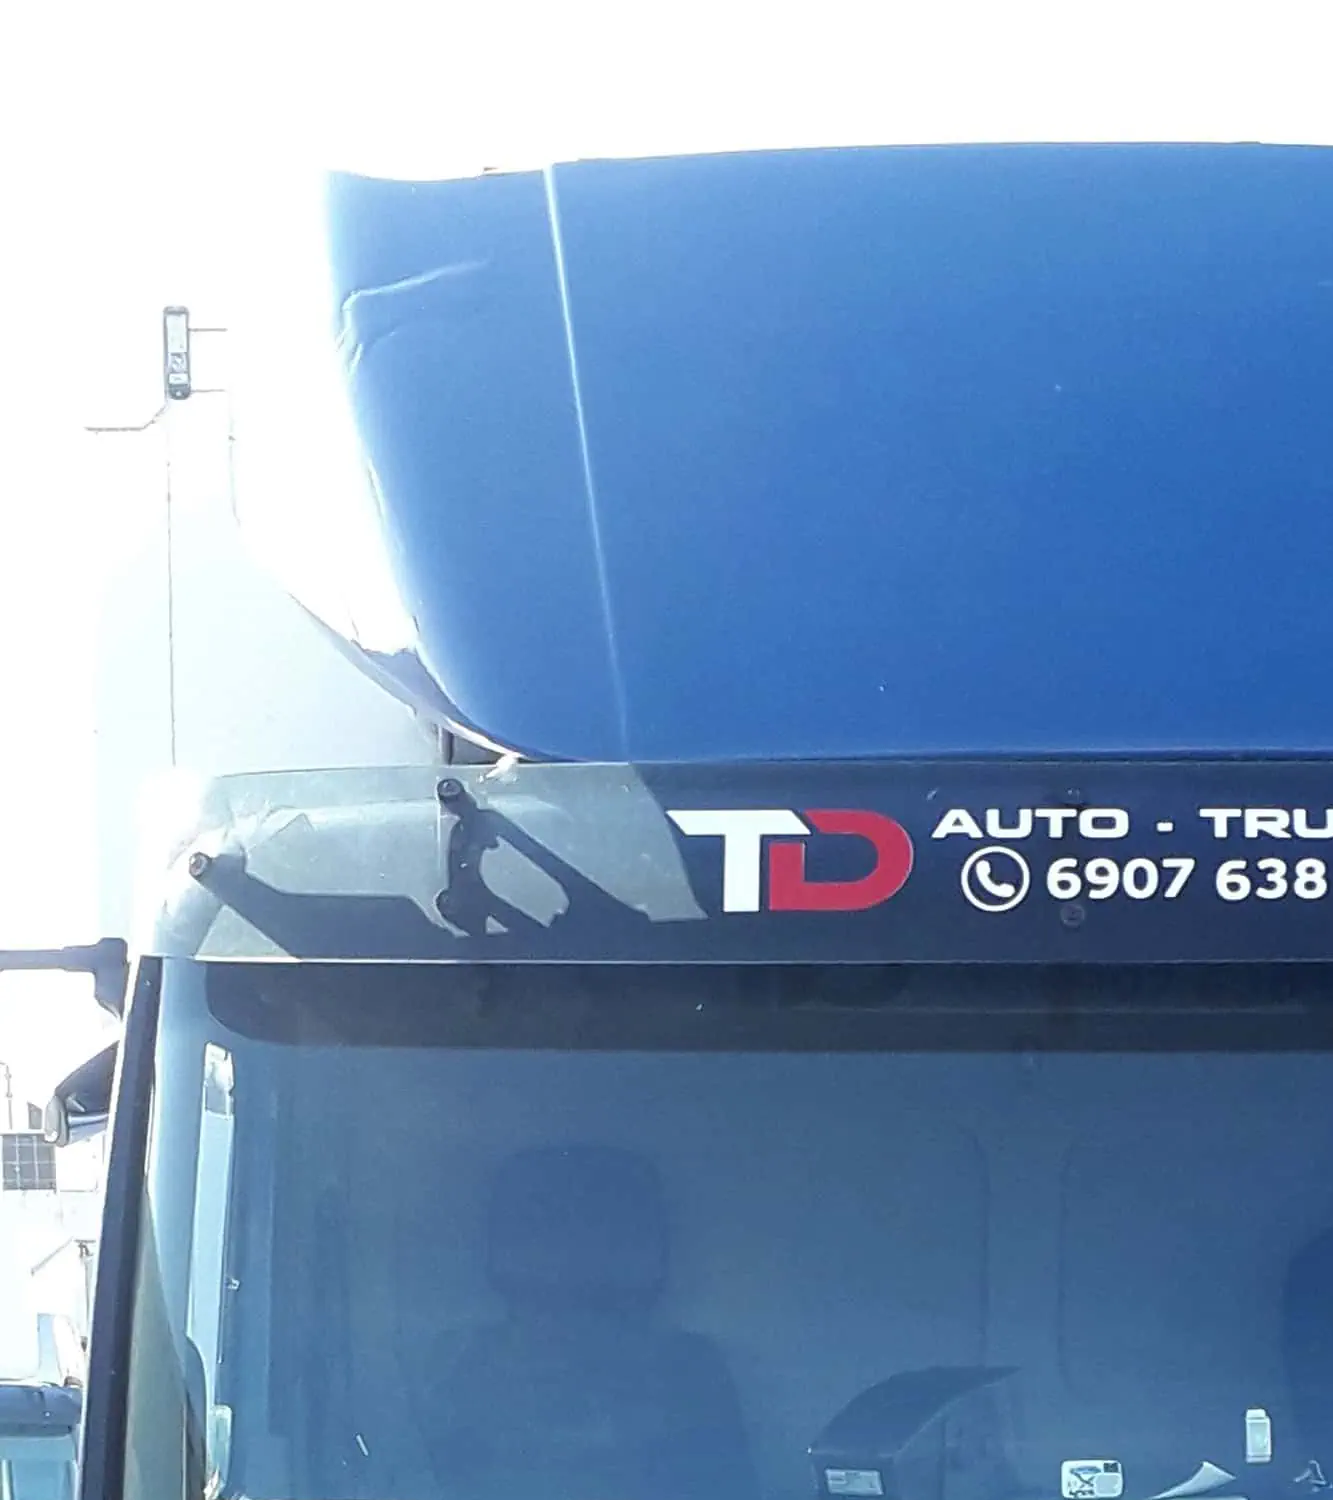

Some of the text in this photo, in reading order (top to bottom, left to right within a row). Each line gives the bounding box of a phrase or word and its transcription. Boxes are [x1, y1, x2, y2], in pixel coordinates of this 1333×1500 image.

[931, 808, 1130, 839] AUTO
[665, 809, 914, 912] TD
[1047, 857, 1195, 900] 6907
[1216, 858, 1327, 901] 638
